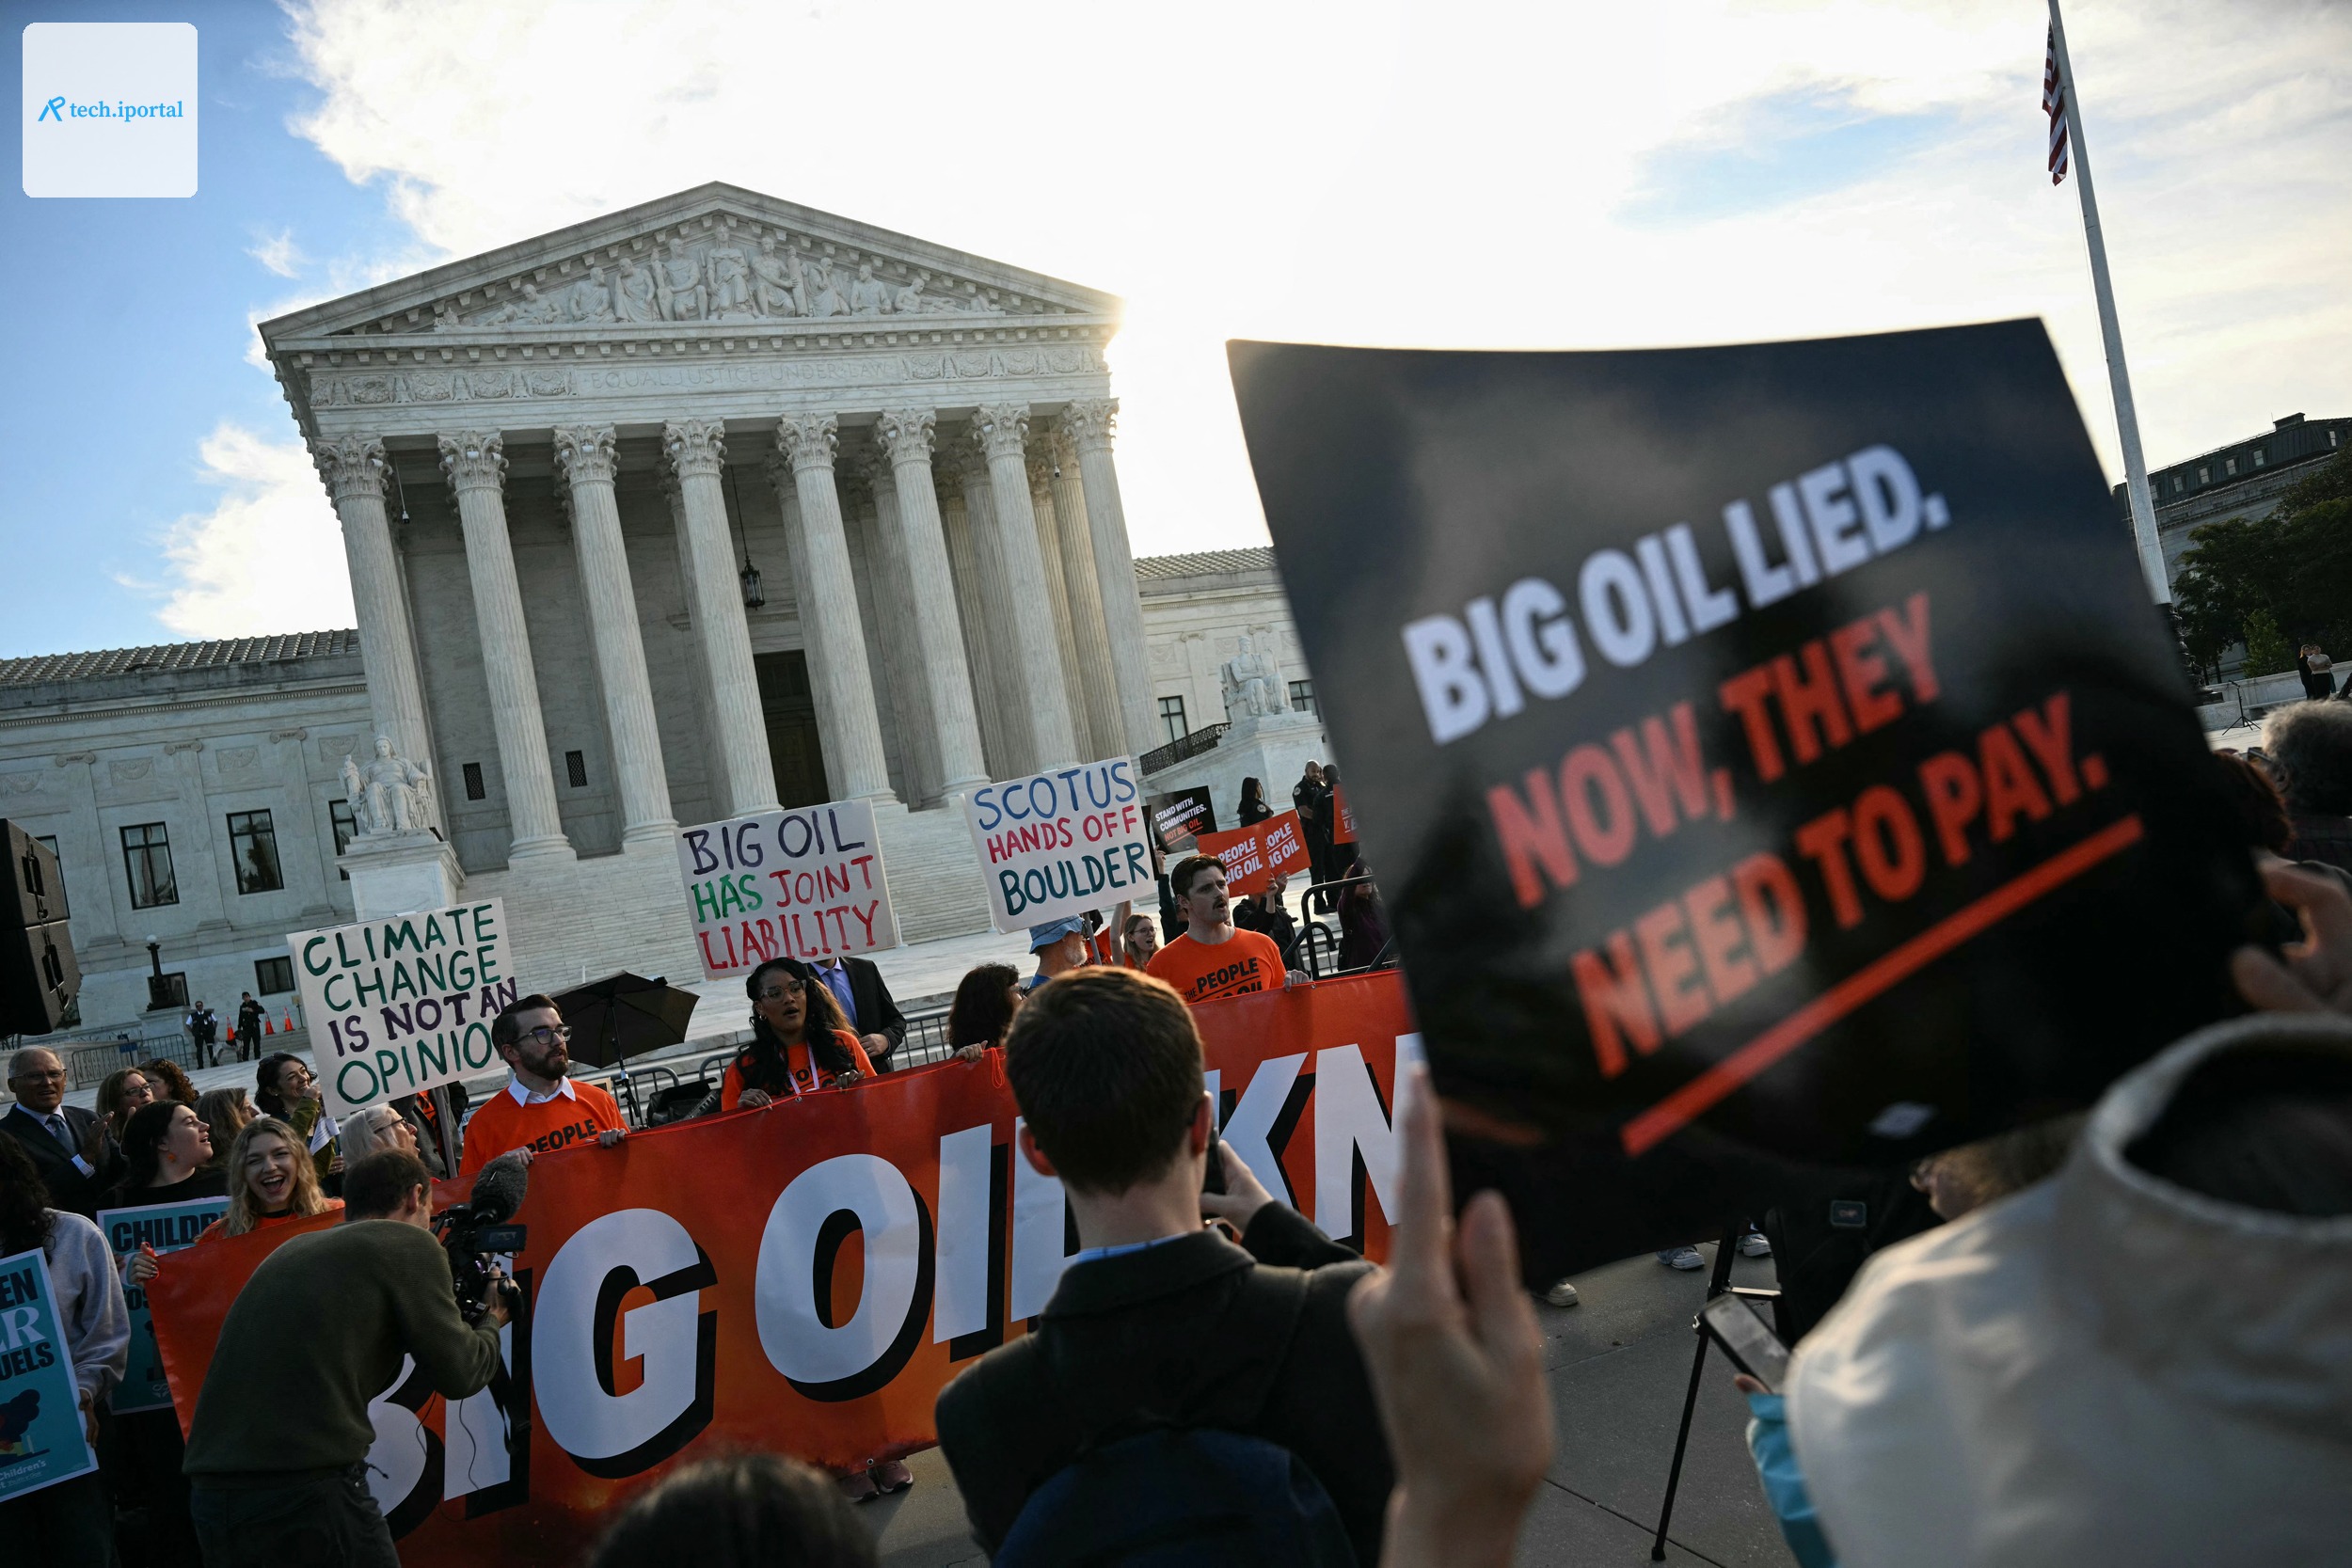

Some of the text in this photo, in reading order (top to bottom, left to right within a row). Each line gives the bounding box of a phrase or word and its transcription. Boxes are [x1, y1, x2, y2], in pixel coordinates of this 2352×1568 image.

[591, 362, 887, 389] EQUAL JUSTICE UNDER LAW
[1401, 443, 1951, 747] BIG OIL LIED.
[1486, 591, 1940, 911] NOW, THEY
[975, 762, 1136, 831] SCOTUS
[1154, 797, 1194, 821] STAND WITH
[1159, 803, 1207, 832] COMMUNITIES.
[1164, 817, 1202, 842] NOT BIG OIL.
[682, 808, 866, 876] BIG OIL
[987, 804, 1137, 864] HANDS OFF
[1217, 836, 1257, 863] PEOPLE
[1243, 855, 1263, 876] OIL
[1265, 821, 1293, 850] OPLE
[1268, 838, 1300, 869] IG OIL
[691, 855, 873, 923] HAS JOINT
[999, 842, 1149, 916] BOULDER
[1569, 690, 2109, 1081] NEED TO PAY.
[303, 904, 498, 976] CLIMATE
[699, 899, 880, 970] LIABILITY
[324, 944, 501, 1012] CHANGE
[1184, 957, 1260, 1002] THE PEOPLE
[327, 976, 518, 1057] IS NOT AN
[337, 1019, 502, 1104] OPINIO
[0, 1306, 46, 1353] R
